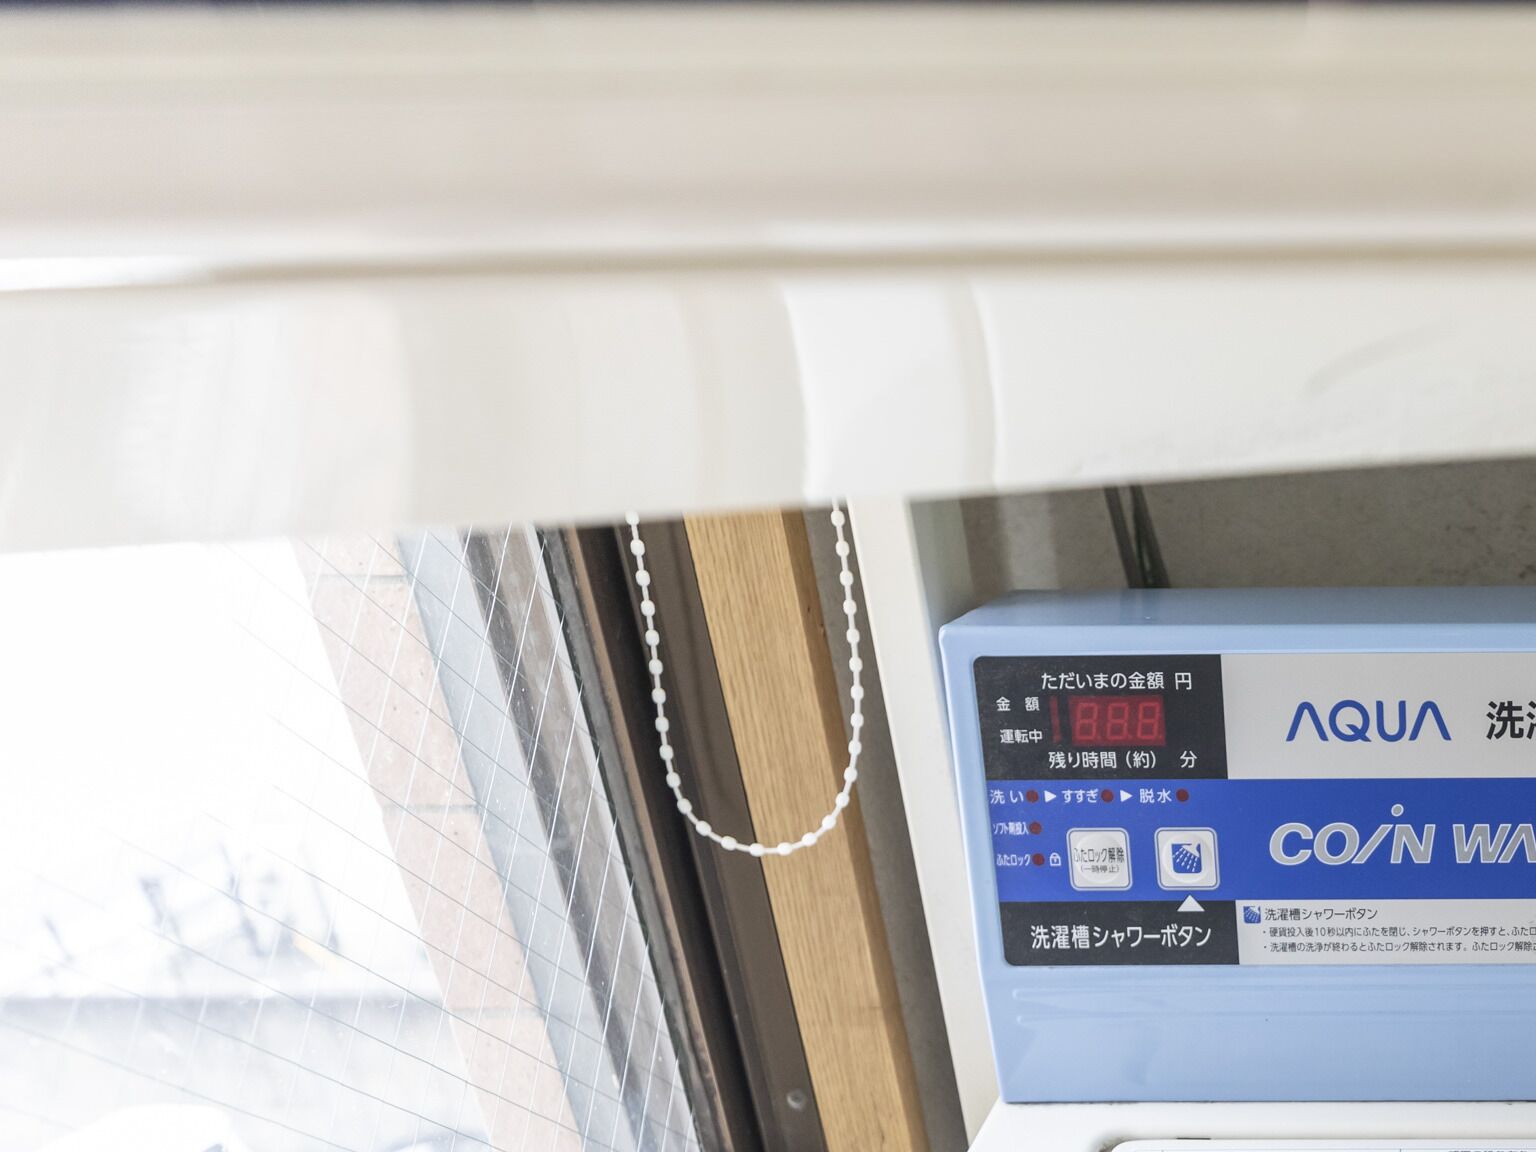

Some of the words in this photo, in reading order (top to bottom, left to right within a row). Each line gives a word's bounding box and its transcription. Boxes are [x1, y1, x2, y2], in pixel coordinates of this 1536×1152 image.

[1041, 671, 1165, 691] ただいまの金額
[1174, 672, 1192, 691] 円
[1285, 698, 1452, 743] AQUA
[999, 728, 1043, 745] 運転中
[1180, 751, 1198, 769] 分
[1062, 789, 1099, 804] すすぎ
[1269, 803, 1436, 866] COIN
[996, 853, 1031, 867] ふたロック
[1073, 847, 1125, 864] ふたロック解除
[1264, 907, 1378, 921] 洗濯槽シャワーボタン
[1030, 924, 1212, 950] 洗濯槽シャワーボタン
